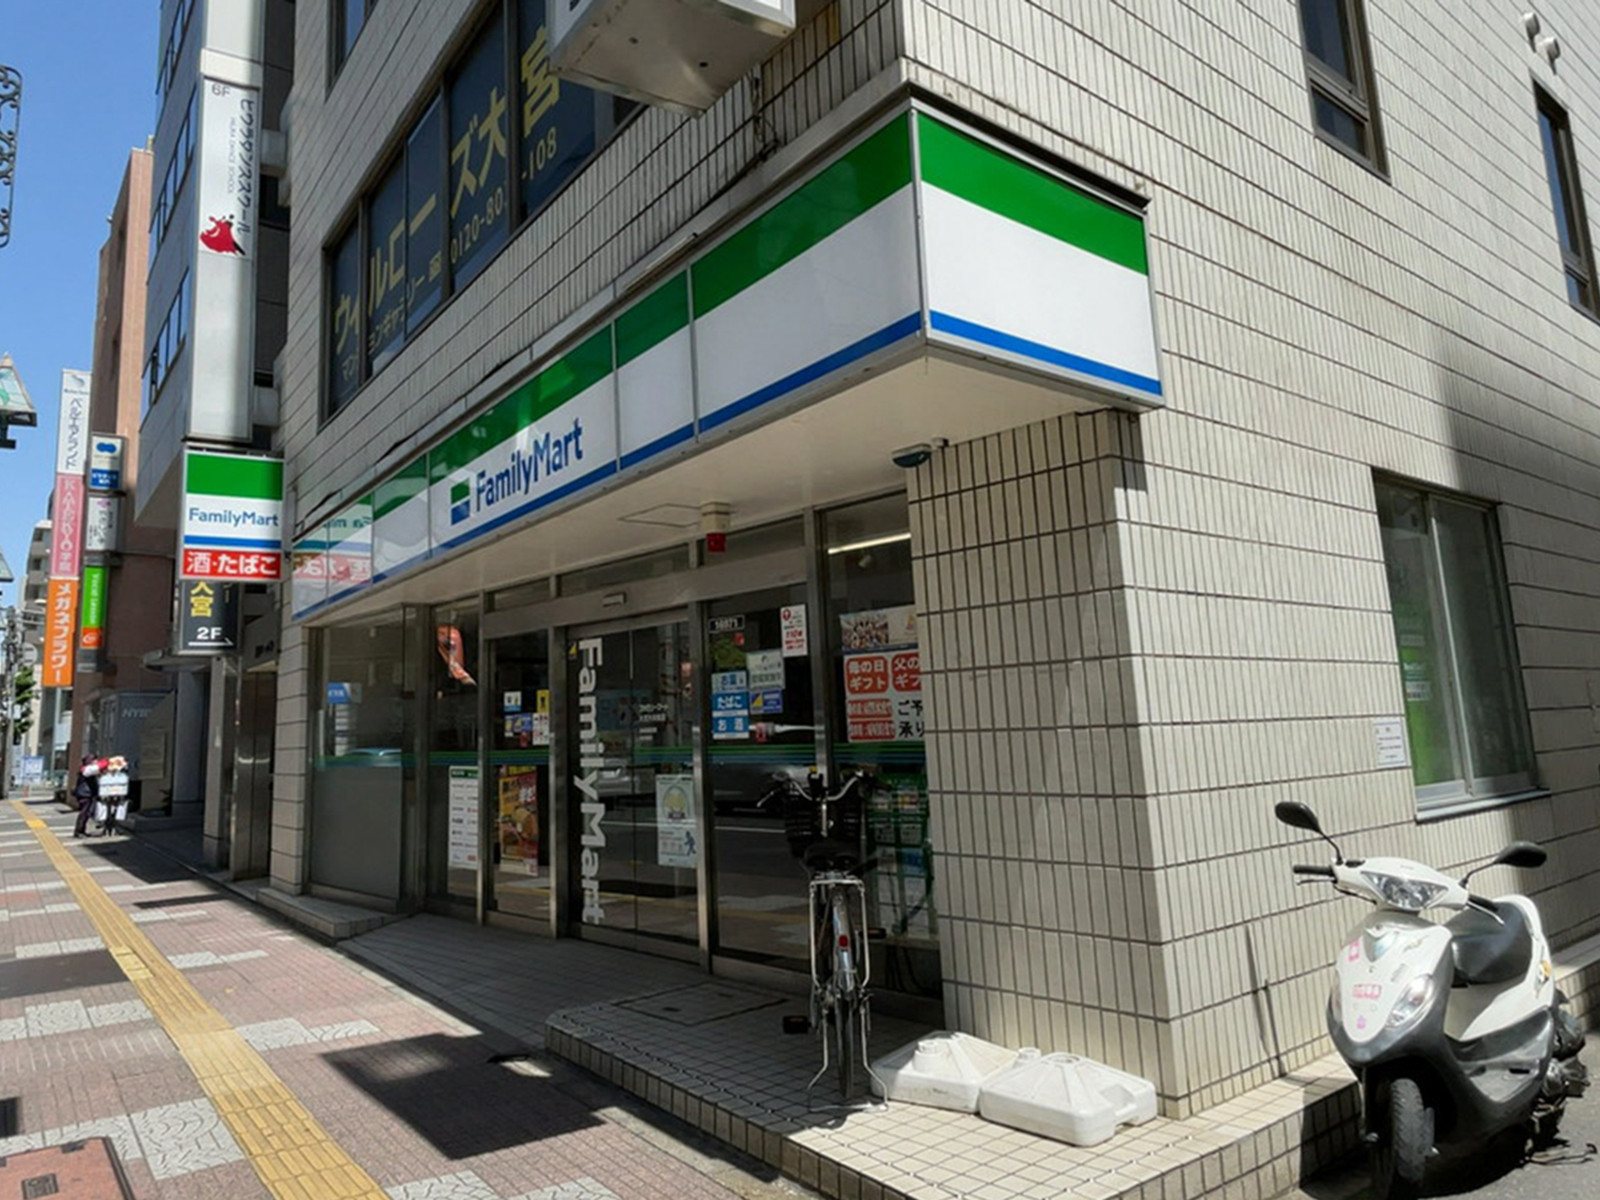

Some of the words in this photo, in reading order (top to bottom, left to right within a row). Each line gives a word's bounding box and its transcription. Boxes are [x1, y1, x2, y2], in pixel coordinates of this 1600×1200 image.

[212, 84, 231, 97] 6F
[475, 417, 584, 513] FamilyMart
[188, 507, 279, 528] FamilyMart
[52, 583, 72, 682] メガネフラワー
[196, 627, 222, 640] 2F
[850, 675, 886, 690] ギフト
[573, 636, 606, 925] FamilyMart
